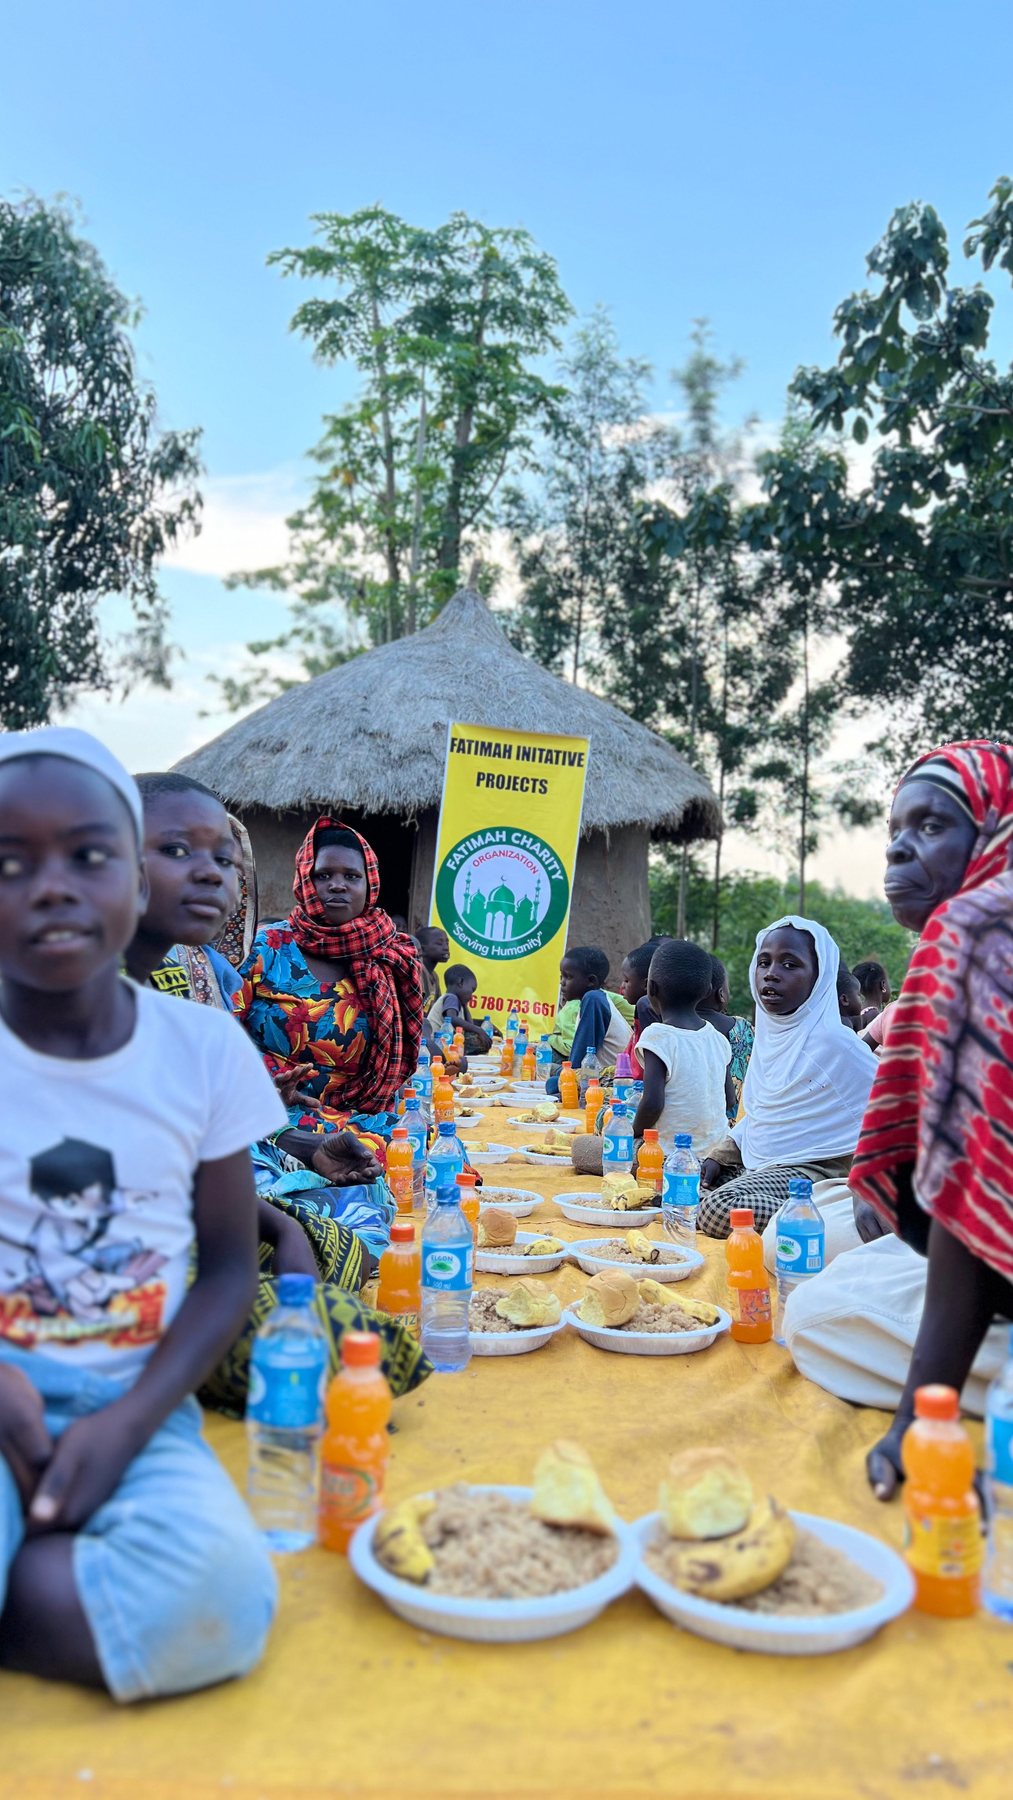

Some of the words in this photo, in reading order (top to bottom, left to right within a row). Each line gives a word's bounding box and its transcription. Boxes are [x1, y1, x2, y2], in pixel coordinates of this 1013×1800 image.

[450, 737, 513, 760] FATIMAH
[515, 745, 585, 768] INITATIVE
[476, 771, 548, 795] PROJECTS
[446, 830, 507, 871] FATIMAH
[511, 832, 564, 880] CHARITY
[472, 850, 539, 875] ORGANIZATION
[480, 996, 504, 1012] 780
[507, 999, 530, 1014] 733
[533, 1001, 556, 1018] 661
[431, 1254, 454, 1262] ELGON
